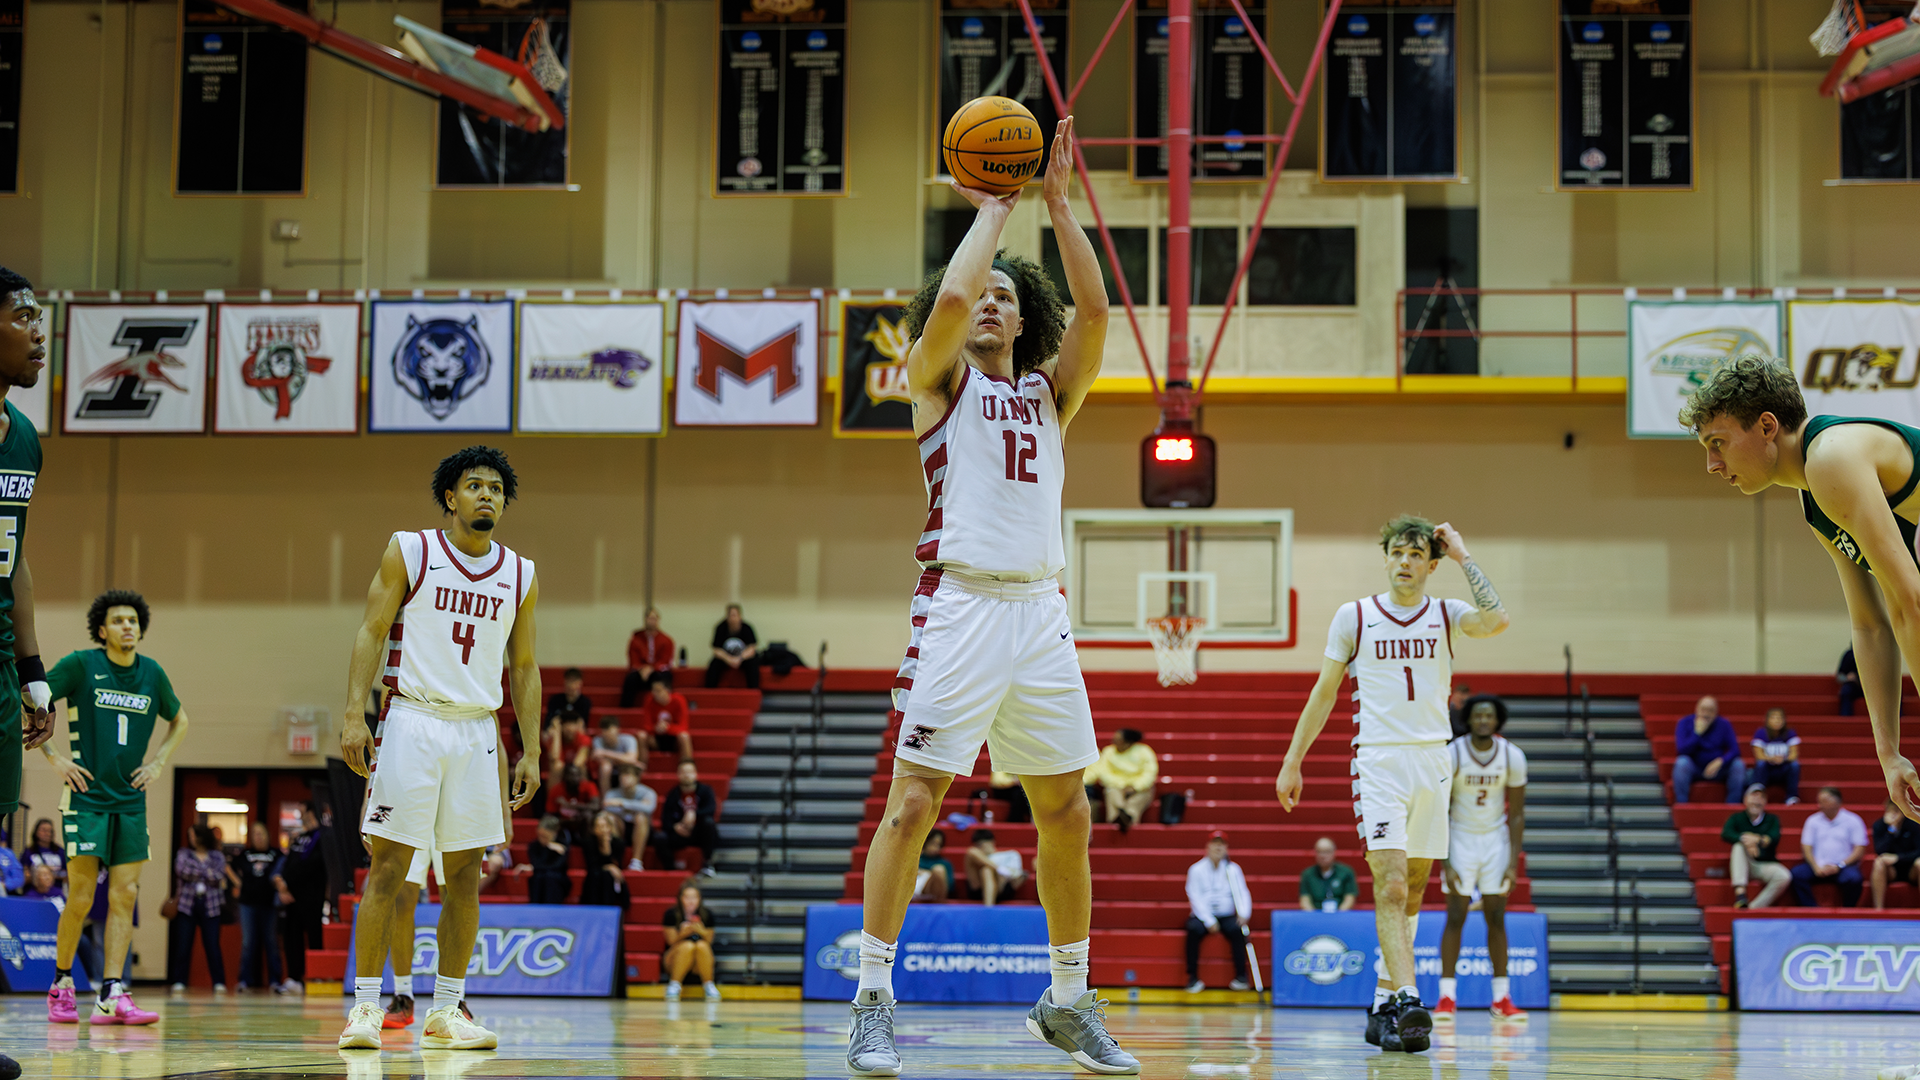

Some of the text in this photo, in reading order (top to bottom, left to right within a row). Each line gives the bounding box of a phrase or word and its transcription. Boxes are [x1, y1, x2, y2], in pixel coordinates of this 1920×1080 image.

[998, 127, 1032, 142] EVO
[982, 157, 1039, 179] Wilson
[981, 394, 1044, 427] UINDY
[1002, 429, 1039, 484] 12
[434, 586, 504, 622] UINDY
[452, 621, 476, 666] 4
[1375, 638, 1438, 660] UINDY
[1404, 666, 1415, 701] 1
[99, 692, 149, 711] MINERS
[117, 713, 129, 746] 1
[1476, 789, 1487, 806] 2
